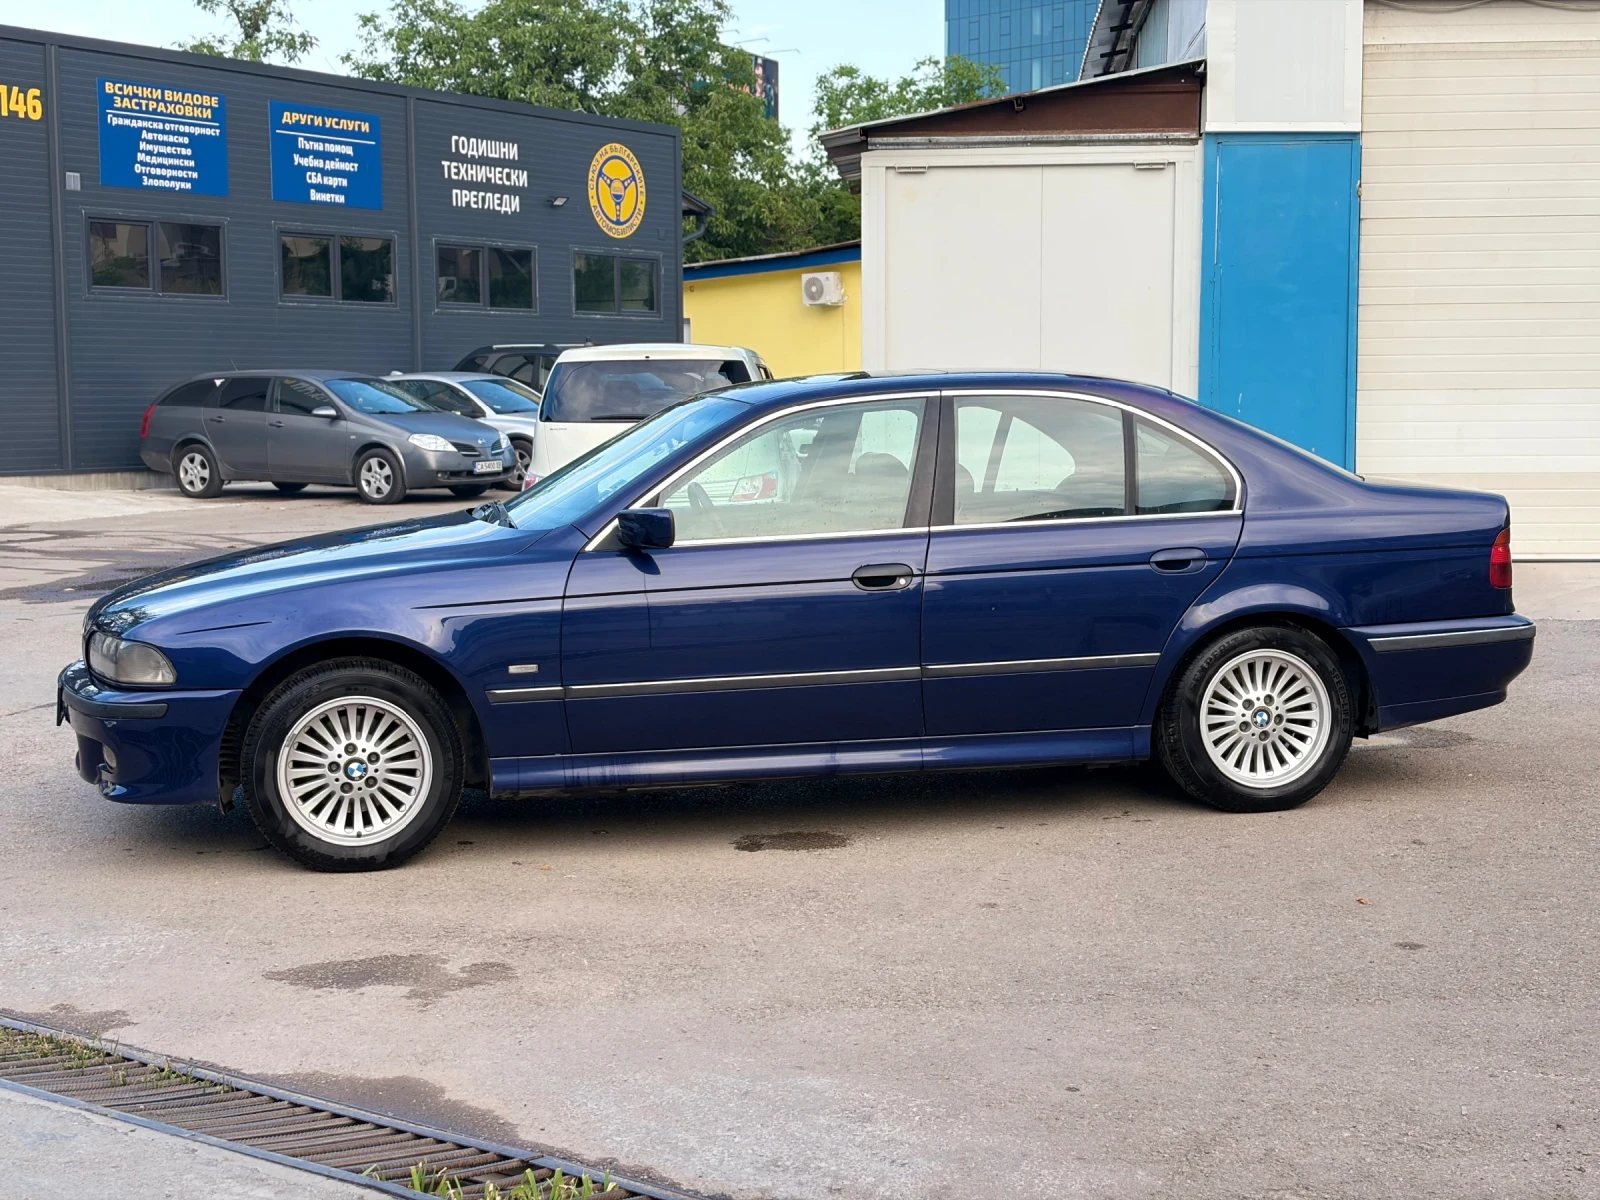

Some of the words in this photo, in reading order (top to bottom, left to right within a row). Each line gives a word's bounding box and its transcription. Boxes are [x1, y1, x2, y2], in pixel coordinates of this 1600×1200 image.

[0, 84, 42, 120] 146
[105, 82, 161, 100] ВСИЧКИ
[164, 90, 219, 108] ВИДОВЕ
[113, 96, 212, 119] ЗАСТРАХОВКИ
[107, 114, 163, 129] Гражданска
[164, 123, 220, 136] отговорност
[282, 111, 322, 127] ДРУГИ
[324, 116, 370, 133] УСЛУГИ
[141, 130, 189, 144] Автокаско
[298, 137, 323, 151] Пътна
[324, 142, 353, 156] помощ
[451, 135, 518, 160] ГОДИШНИ
[137, 152, 195, 167] Медицински
[139, 141, 192, 156] Имущество
[134, 163, 198, 179] Отговорности
[293, 153, 324, 168] Учебна
[324, 157, 358, 172] дейност
[589, 158, 601, 190] СЪЮЗ
[600, 148, 609, 158] НА
[609, 144, 645, 197] БЪЛГАРСКИТЕ
[142, 175, 191, 190] Злополуки
[306, 171, 322, 184] СБА
[323, 175, 348, 188] карти
[441, 160, 528, 188] ТЕХНИЧЕСКИ
[310, 188, 345, 203] Винетки
[452, 188, 520, 215] ПРЕГЛЕДИ
[592, 205, 643, 236] АВТОМОБИЛИСТИ
